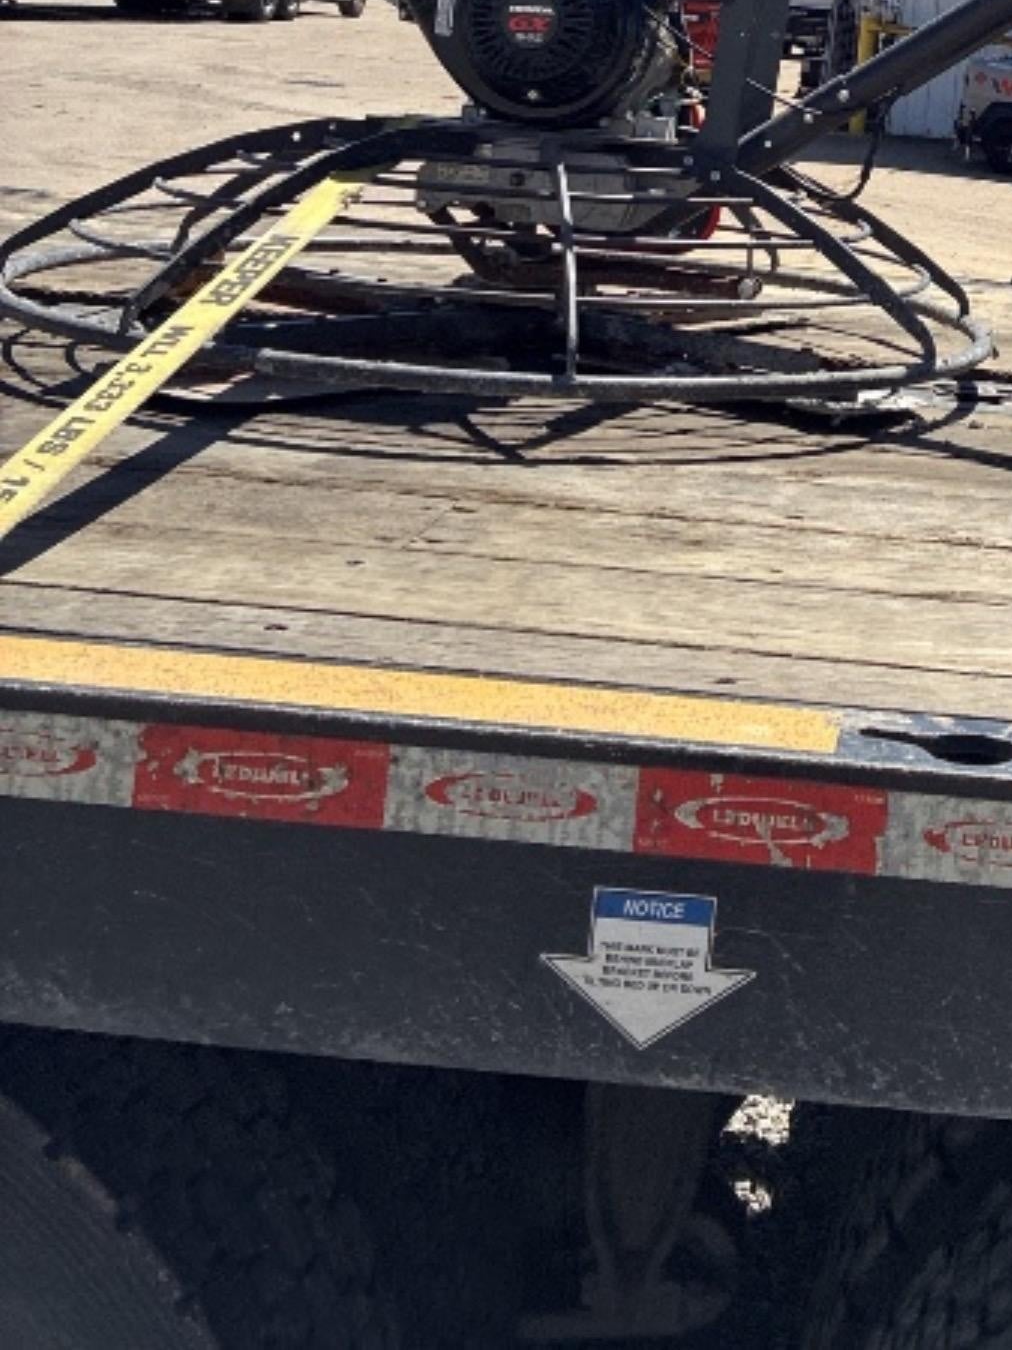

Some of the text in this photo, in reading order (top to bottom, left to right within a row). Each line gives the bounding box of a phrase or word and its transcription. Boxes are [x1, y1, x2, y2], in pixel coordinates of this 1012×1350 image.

[200, 235, 300, 306] KEEPER
[38, 416, 95, 457] LBS
[623, 899, 687, 919] NOTICE
